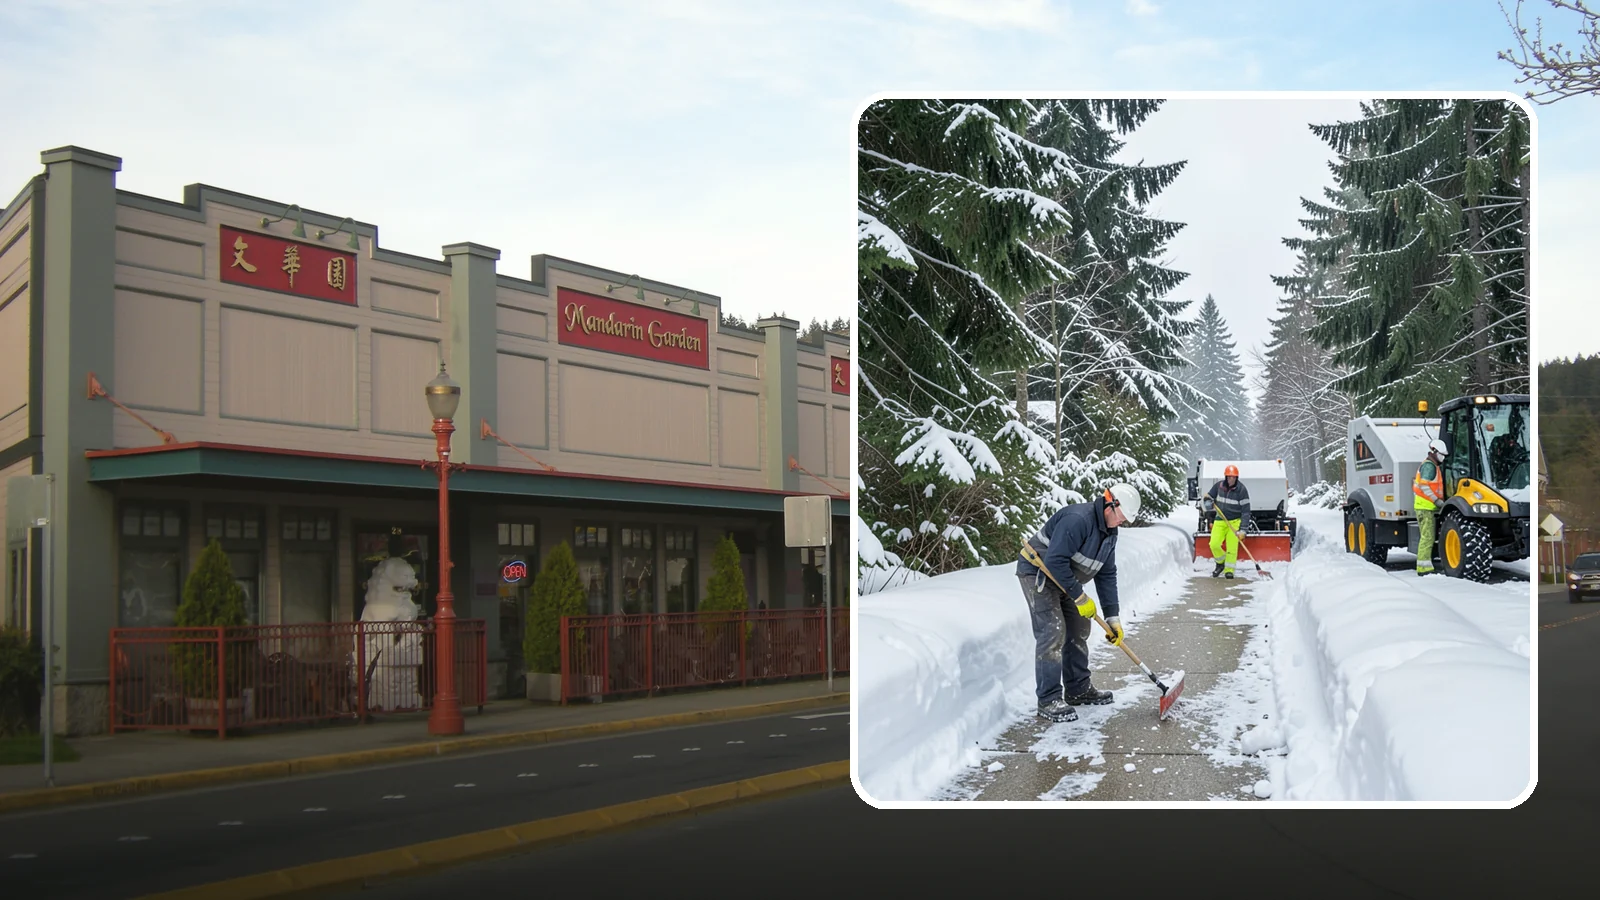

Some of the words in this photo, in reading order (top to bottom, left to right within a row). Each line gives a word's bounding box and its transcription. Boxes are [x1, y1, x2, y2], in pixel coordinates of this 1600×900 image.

[230, 235, 346, 291] 文華園
[564, 302, 644, 341] Mandarin
[647, 320, 702, 352] Garden
[503, 565, 526, 578] OPEN
